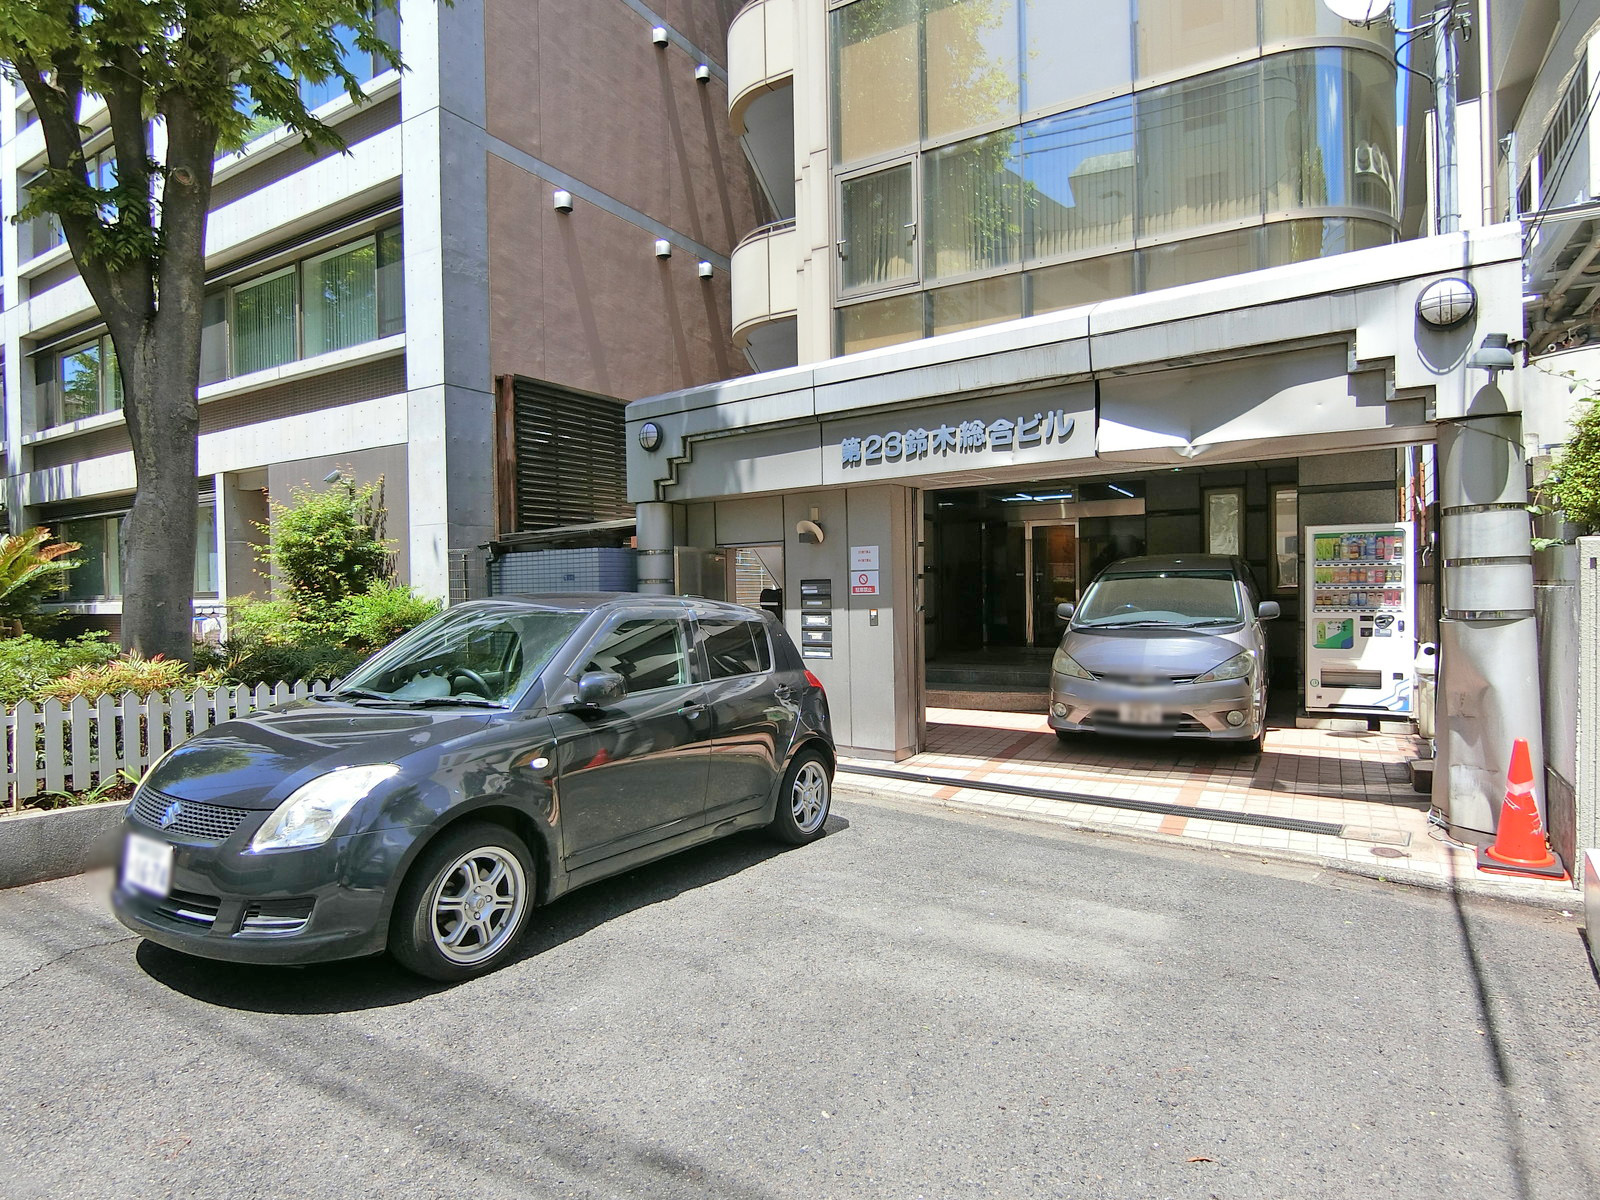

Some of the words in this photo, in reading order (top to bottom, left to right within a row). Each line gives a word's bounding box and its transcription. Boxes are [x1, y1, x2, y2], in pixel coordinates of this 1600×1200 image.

[841, 409, 1075, 463] 第23鈴木総合ビル
